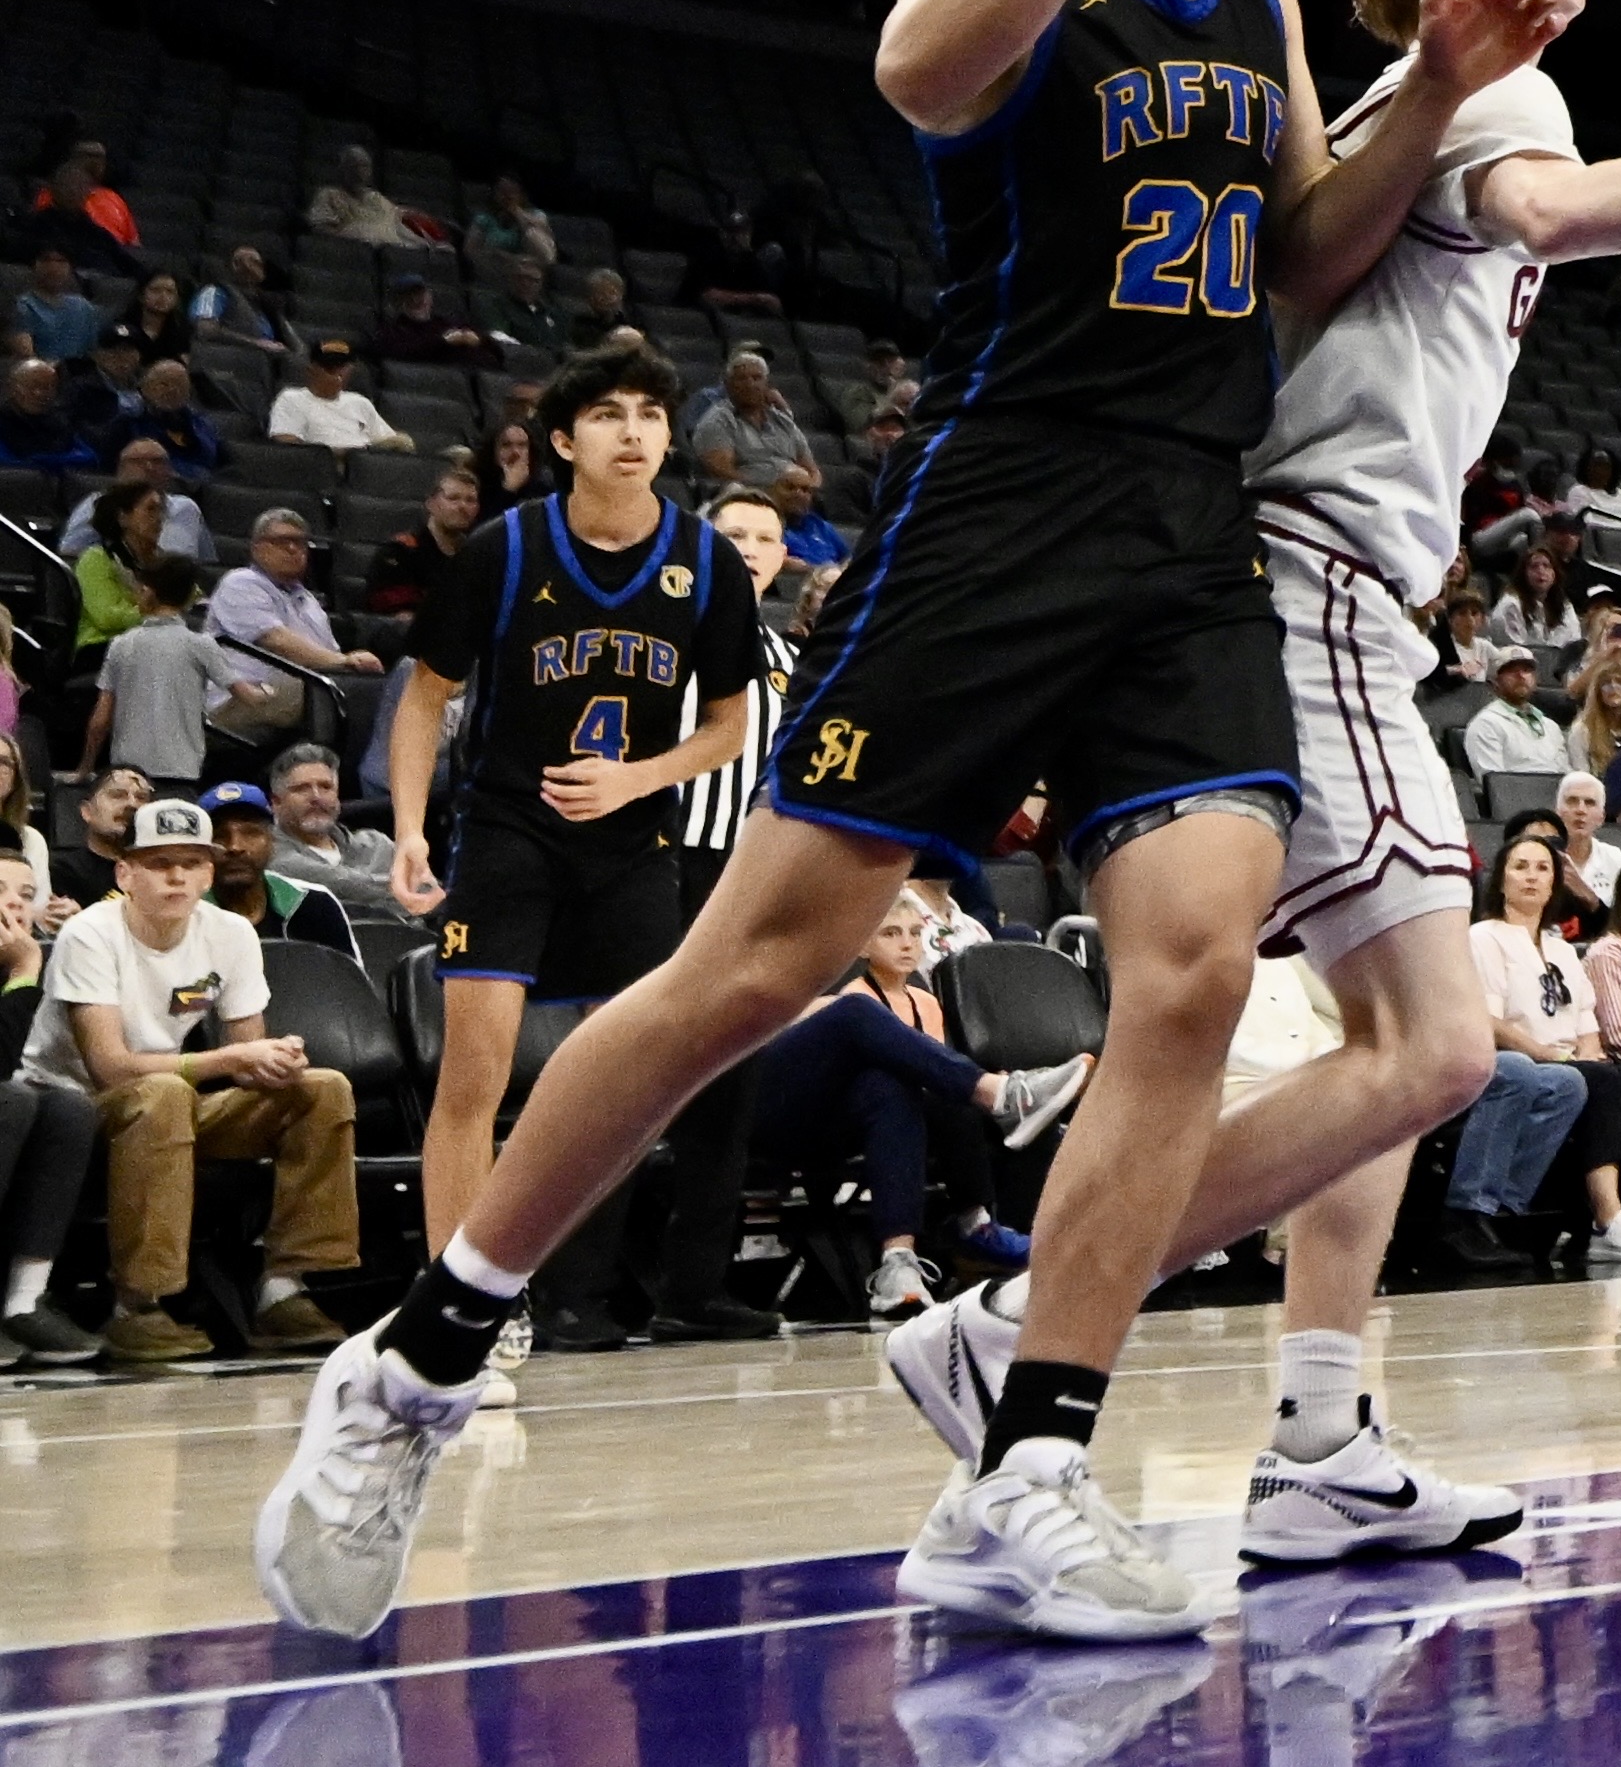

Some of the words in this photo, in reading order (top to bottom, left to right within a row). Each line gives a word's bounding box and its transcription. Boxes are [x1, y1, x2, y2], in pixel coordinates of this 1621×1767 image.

[1109, 178, 1265, 319] 20
[532, 628, 680, 688] RFTB
[570, 695, 630, 763] 4
